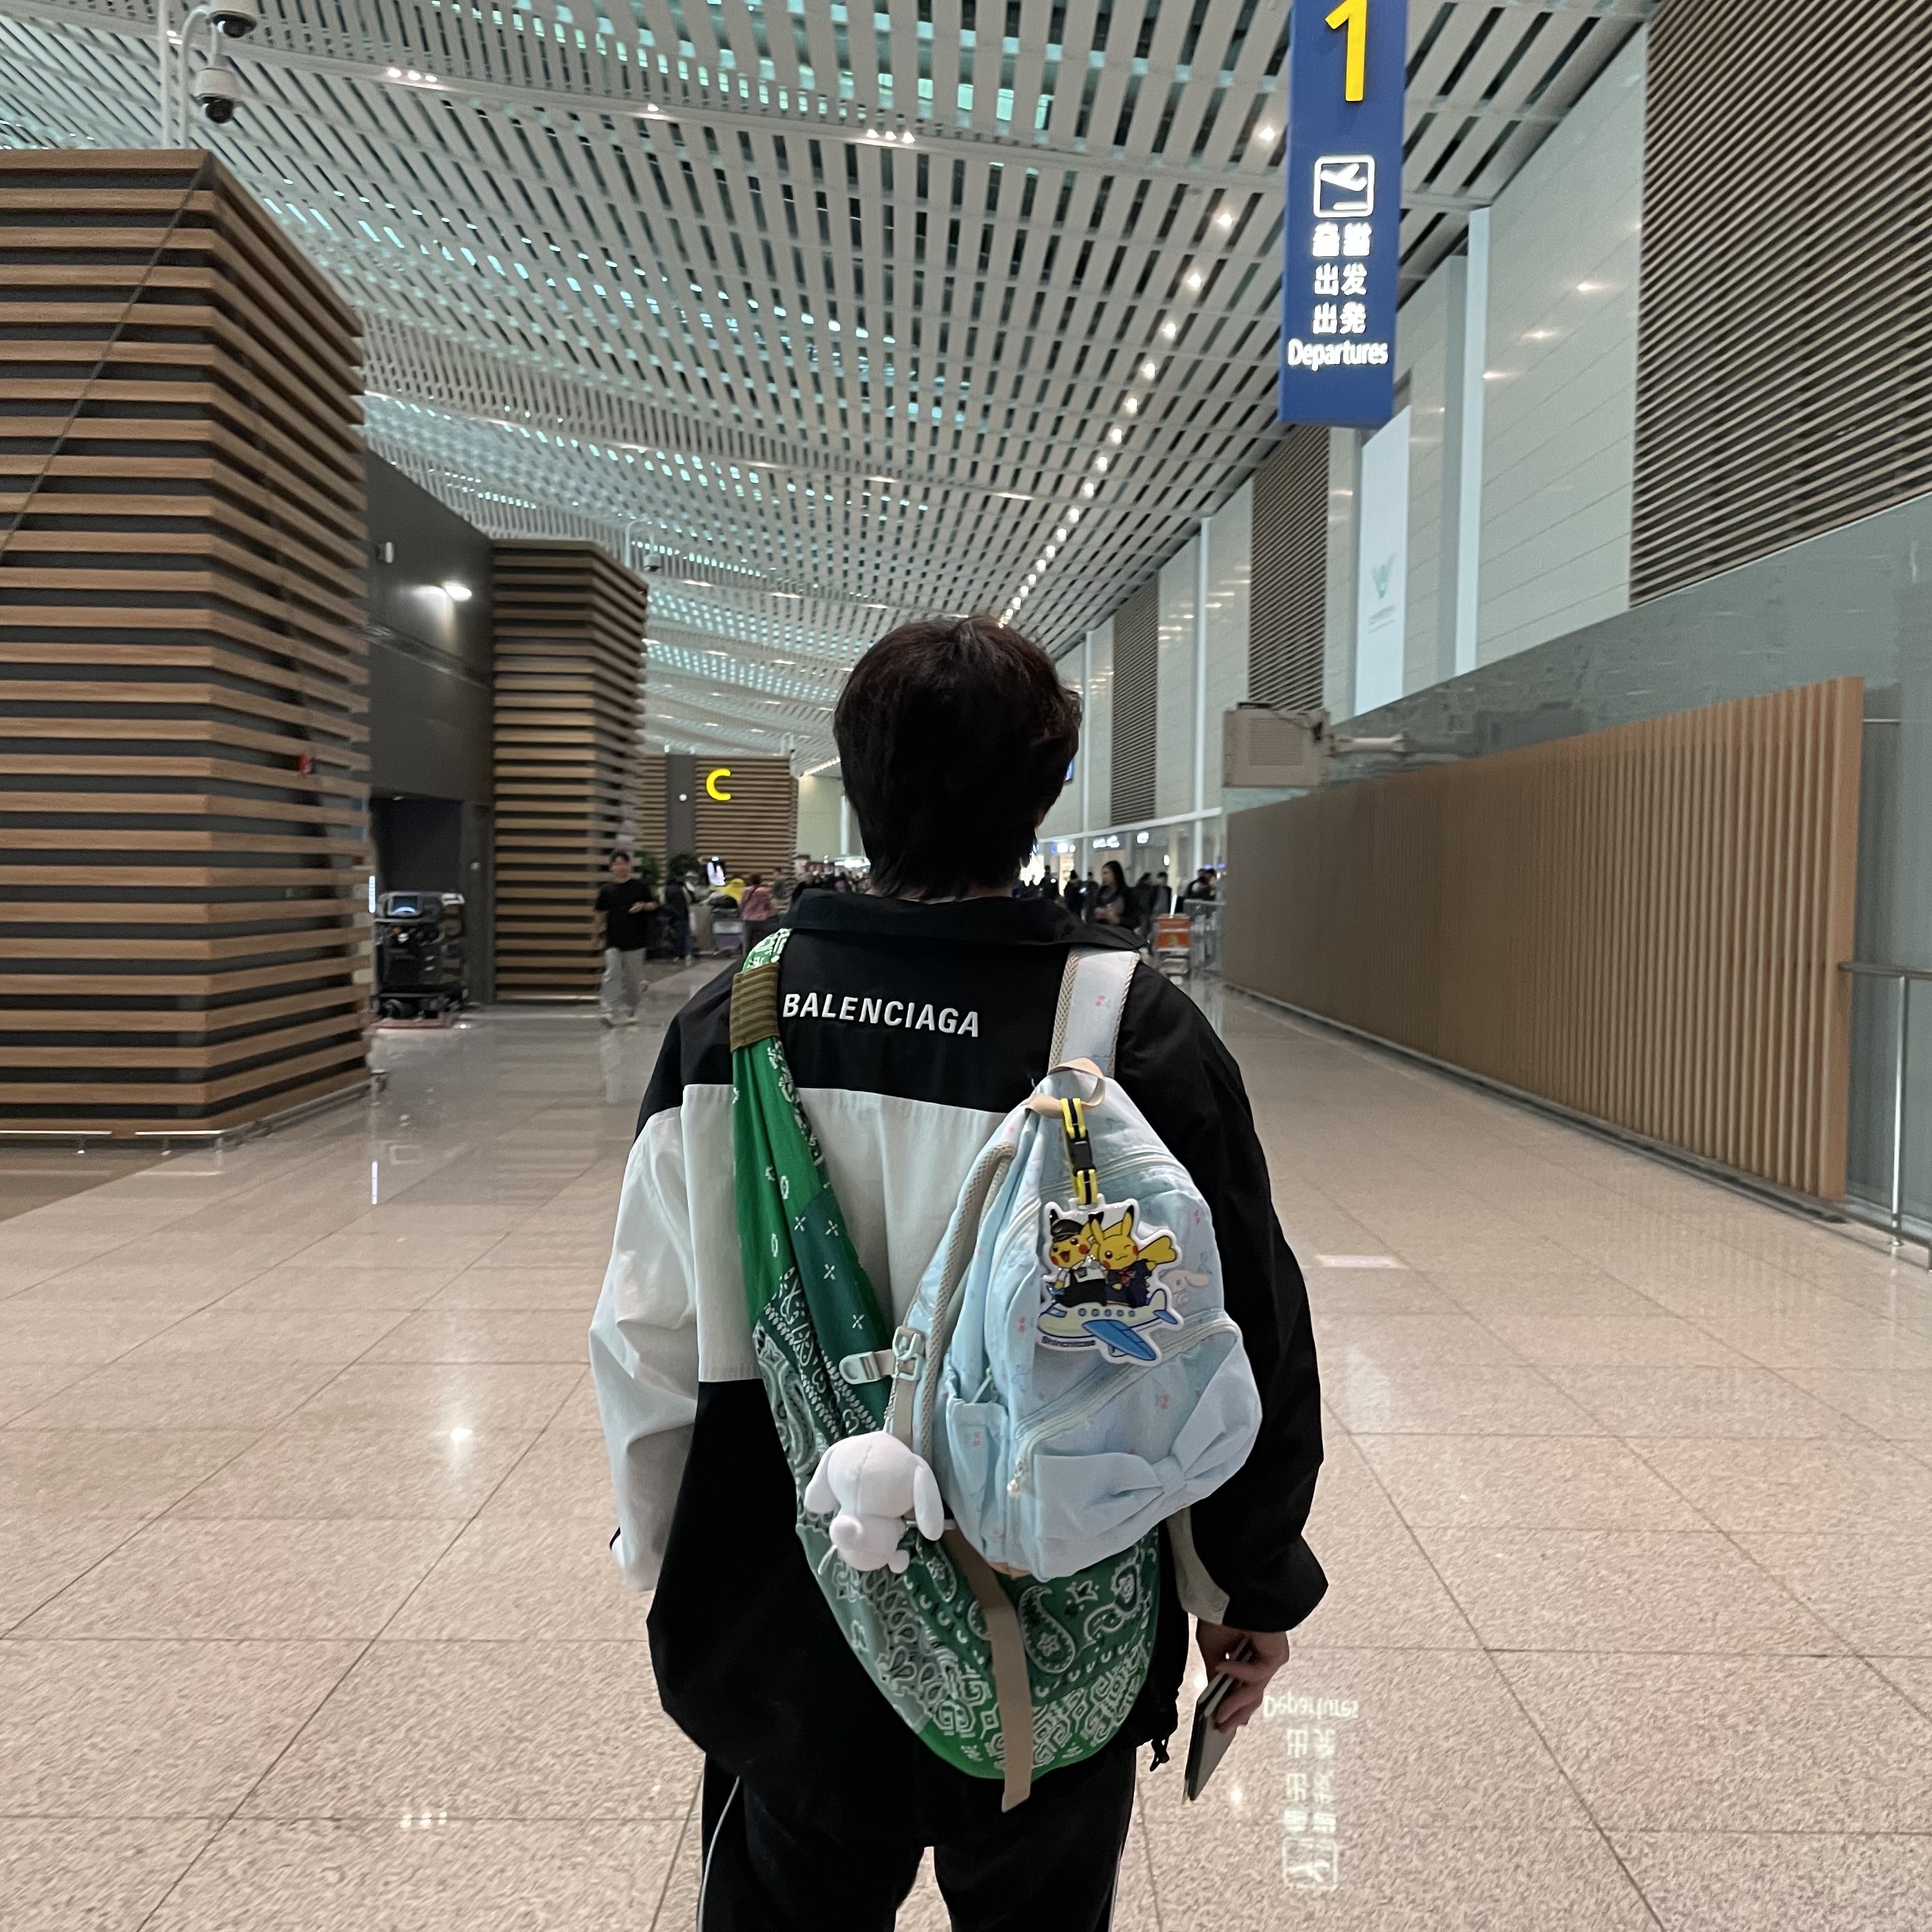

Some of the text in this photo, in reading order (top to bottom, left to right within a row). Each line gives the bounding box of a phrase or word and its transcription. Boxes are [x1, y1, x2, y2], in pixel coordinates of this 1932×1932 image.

[1324, 0, 1367, 102] 1
[1314, 263, 1367, 296] 出发
[1312, 302, 1367, 334] 出発
[1287, 339, 1389, 371] Departures
[706, 769, 731, 801] C
[782, 992, 979, 1038] BALENCIAGA
